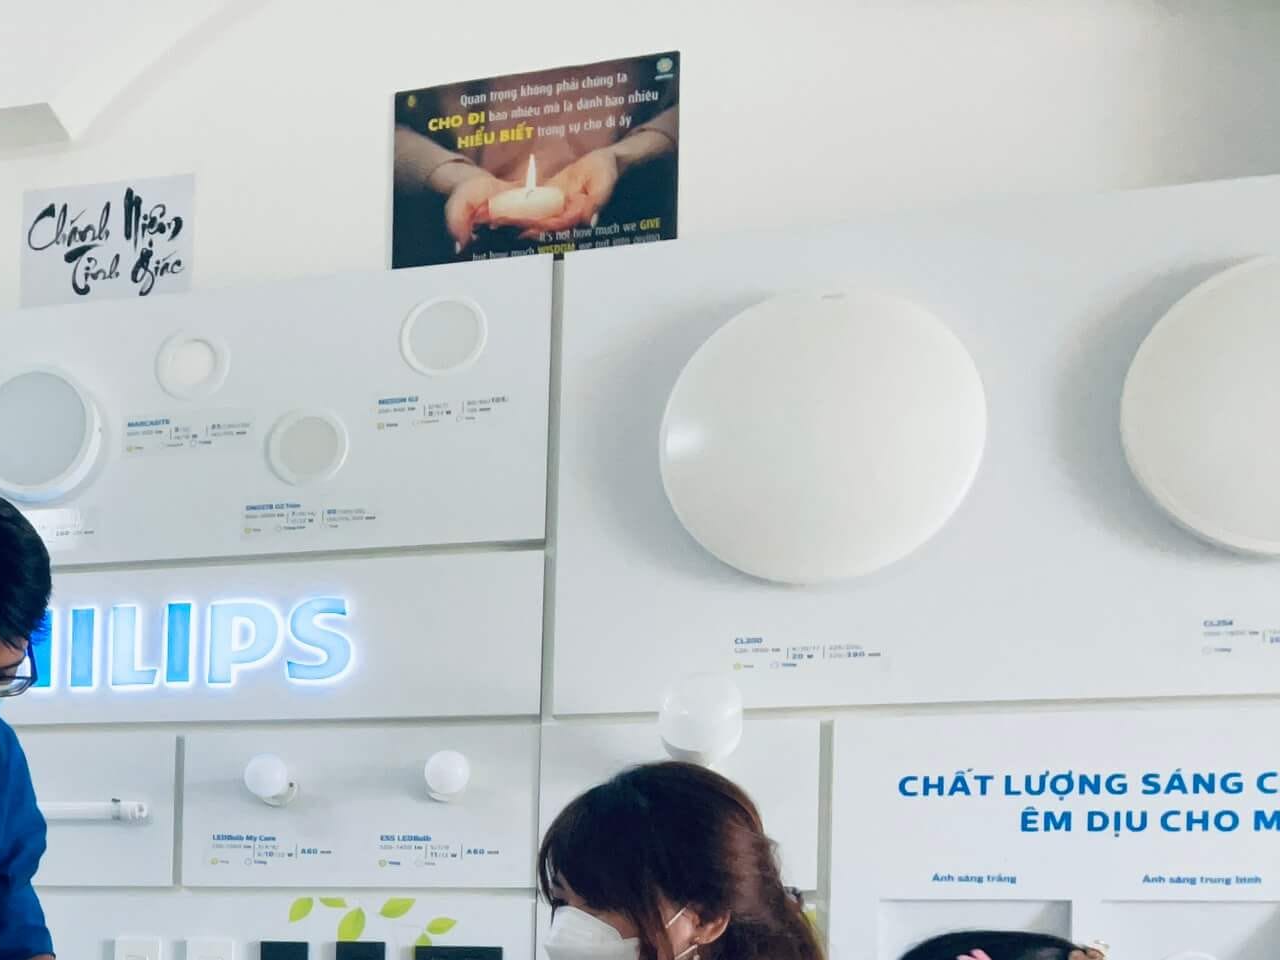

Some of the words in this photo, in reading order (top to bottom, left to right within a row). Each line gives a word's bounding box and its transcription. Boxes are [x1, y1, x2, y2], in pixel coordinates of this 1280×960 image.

[459, 93, 487, 107] Quan
[489, 89, 518, 104] trọng
[520, 81, 553, 98] không
[616, 72, 628, 83] ta
[428, 115, 463, 132] CHO
[467, 111, 485, 126] ĐI
[488, 109, 508, 122] bao
[604, 95, 625, 107] bao
[457, 128, 495, 149] HIỂU
[499, 121, 535, 142] BIẾT
[537, 125, 565, 137] trong
[568, 122, 581, 134] sự
[583, 118, 603, 131] cho
[605, 114, 616, 128] đi
[555, 228, 570, 240] not
[572, 227, 592, 239] how
[594, 224, 620, 237] much
[622, 223, 637, 233] we
[639, 217, 661, 230] GIVE
[898, 767, 994, 797] CHẤT
[1004, 769, 1129, 801] LƯỢNG
[1140, 767, 1245, 796] SÁNG
[1019, 806, 1072, 833] ÊM
[1086, 810, 1149, 838] DỊU
[1159, 809, 1241, 833] CHO
[931, 872, 955, 883] Ánh
[957, 873, 984, 885] sáng
[986, 872, 1017, 885] trắng
[1141, 873, 1167, 885] Ánh
[1169, 874, 1196, 886] sáng
[1199, 875, 1232, 886] trung
